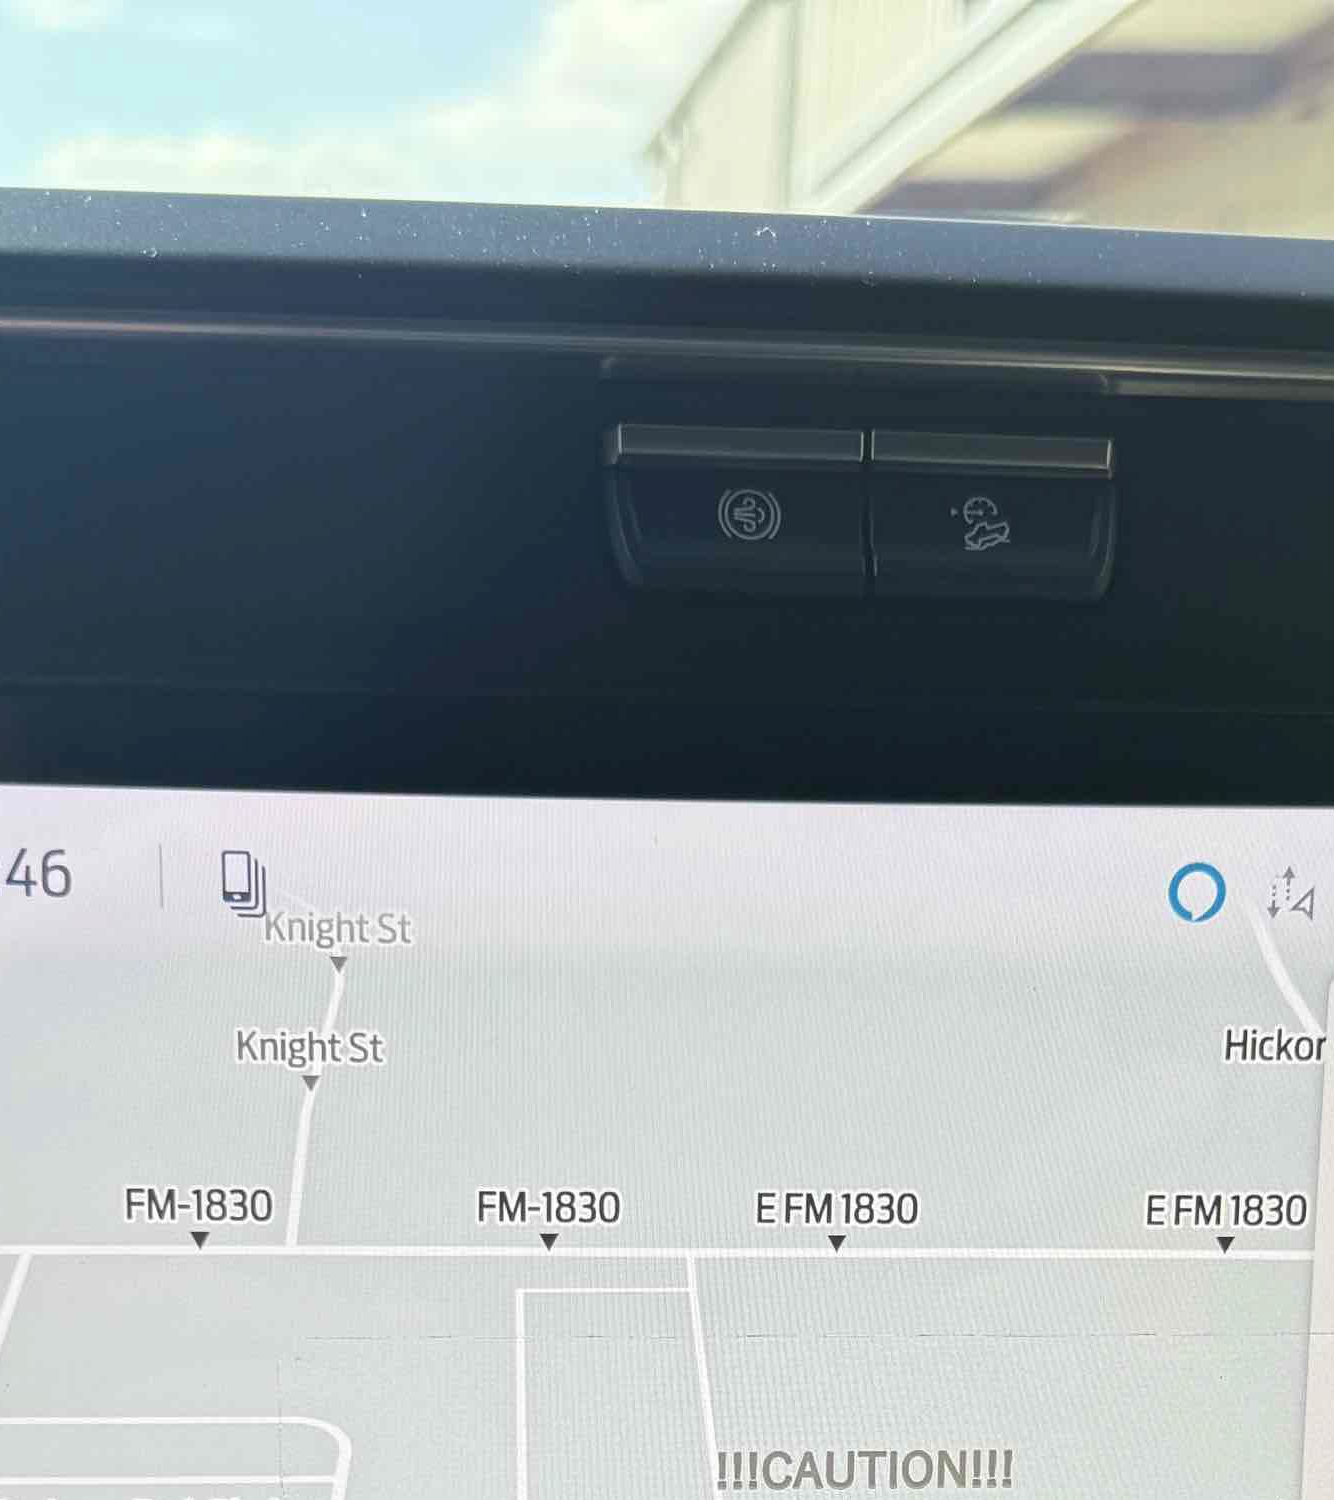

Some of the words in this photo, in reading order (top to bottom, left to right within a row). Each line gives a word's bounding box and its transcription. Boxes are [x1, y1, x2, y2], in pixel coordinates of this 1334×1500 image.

[264, 910, 369, 949] Knight
[375, 912, 411, 946] St
[237, 1031, 341, 1067] Knight
[346, 1032, 383, 1063] St
[1225, 1028, 1327, 1061] Hickor
[125, 1187, 273, 1223] FM-1830
[476, 1190, 620, 1226] FM-1830
[755, 1191, 775, 1226] E
[783, 1191, 832, 1226] FM
[838, 1191, 919, 1226] 1830
[1145, 1195, 1164, 1227] E
[1173, 1195, 1222, 1227] FM
[1231, 1195, 1307, 1227] 1830
